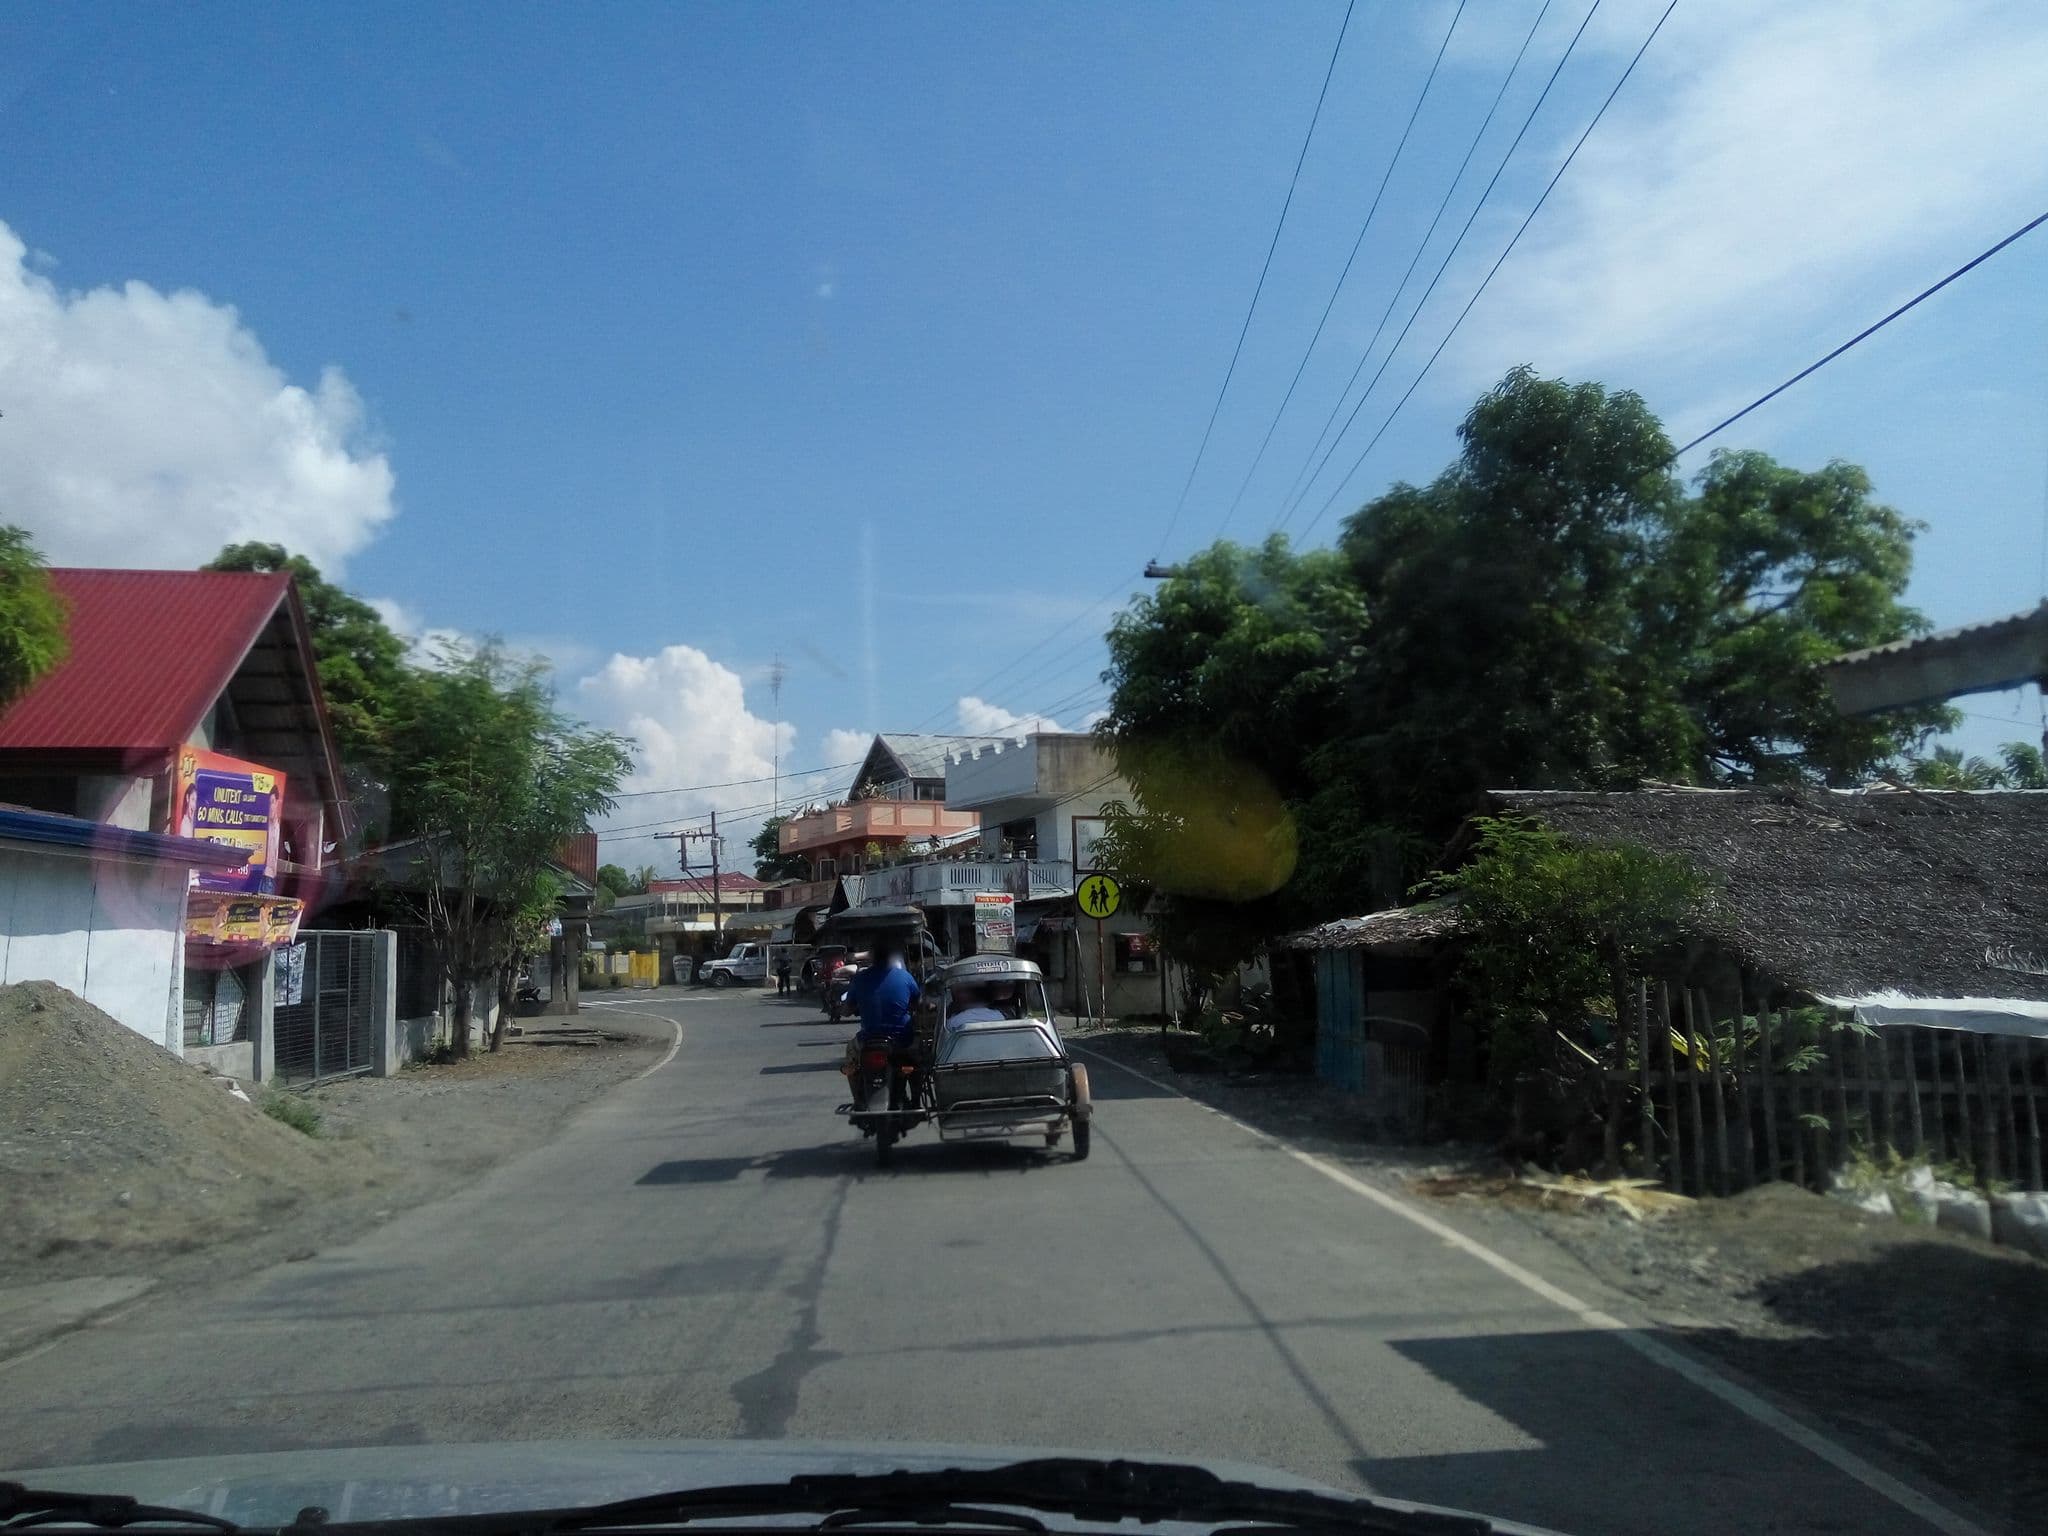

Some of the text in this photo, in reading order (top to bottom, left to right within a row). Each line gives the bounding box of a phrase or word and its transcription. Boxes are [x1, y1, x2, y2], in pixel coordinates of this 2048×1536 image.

[197, 806, 207, 822] 60
[207, 807, 224, 823] MINS
[225, 808, 244, 825] CALLS
